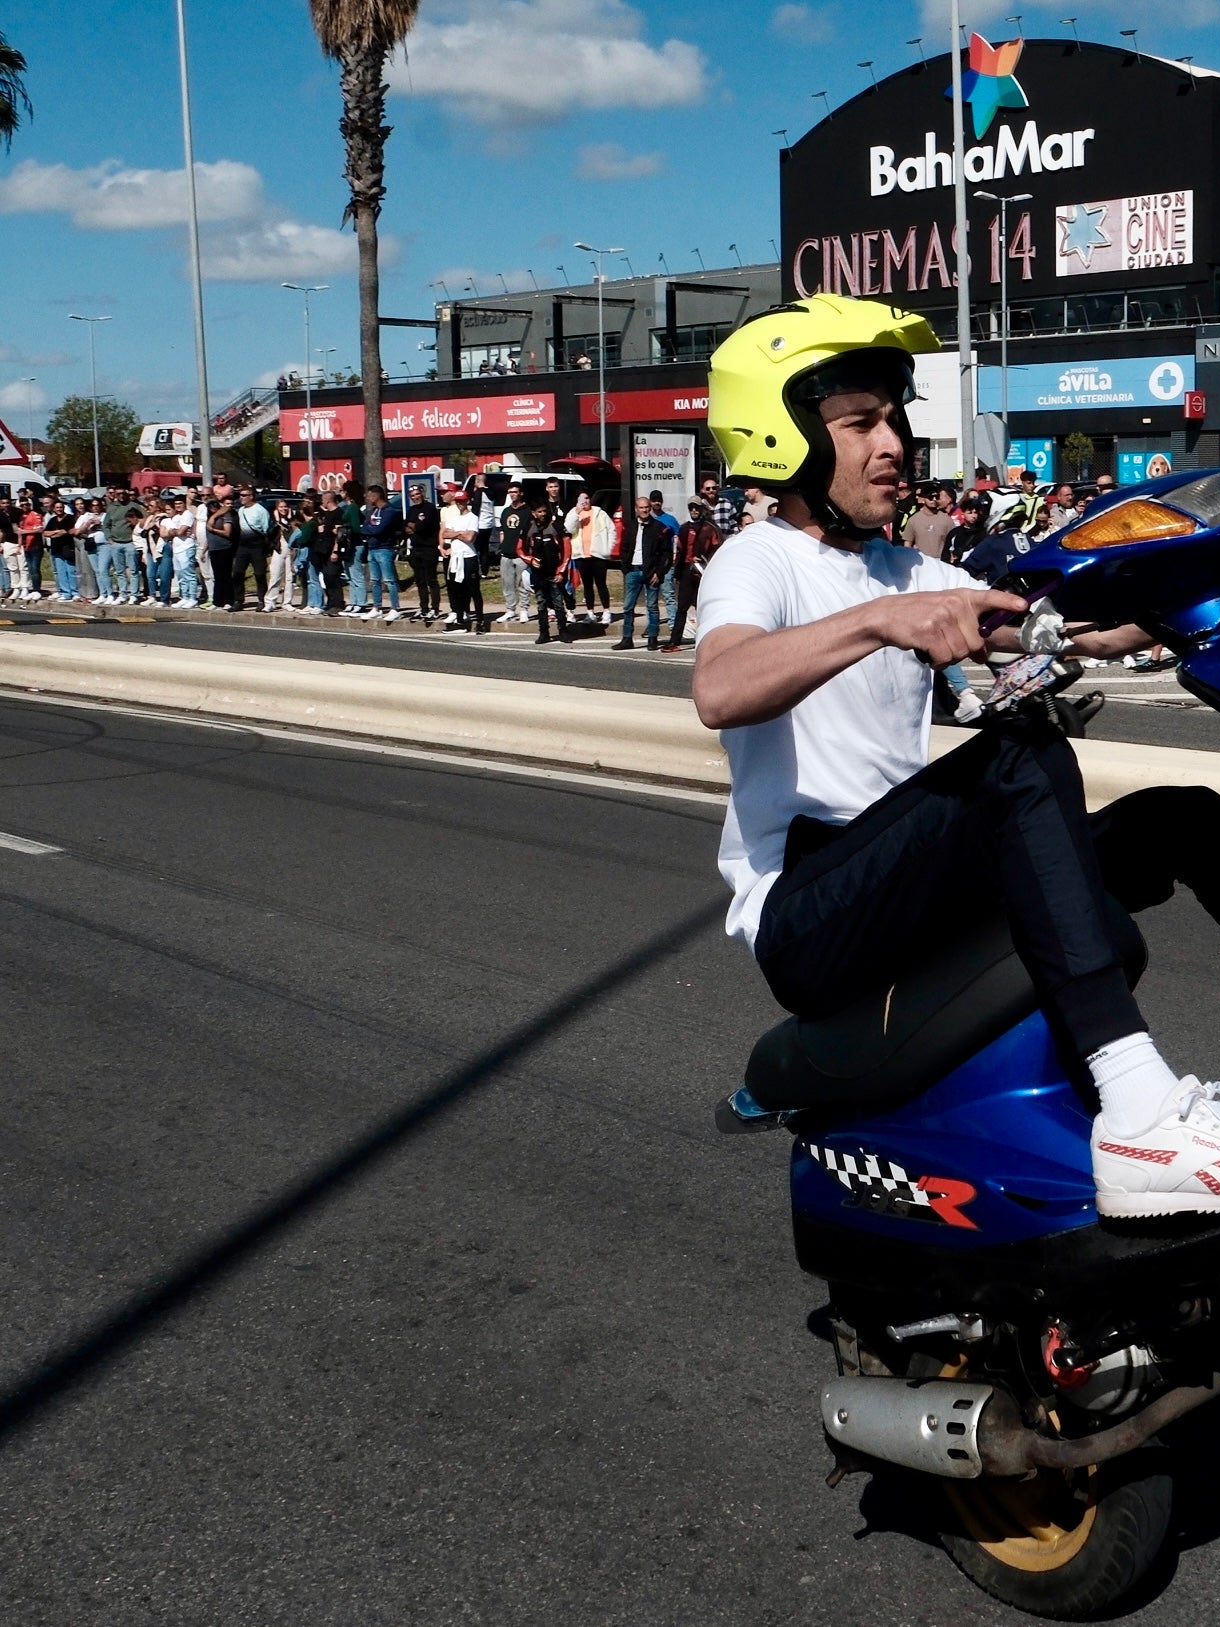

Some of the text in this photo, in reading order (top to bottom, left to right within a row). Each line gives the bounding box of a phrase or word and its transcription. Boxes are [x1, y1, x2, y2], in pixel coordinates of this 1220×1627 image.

[1128, 193, 1185, 212] UNION
[1127, 209, 1187, 254] CINE
[988, 212, 1037, 284] 14
[1128, 252, 1186, 269] CIUDAD
[674, 399, 690, 410] KIA
[1037, 392, 1135, 406] CLÍNICA VETERINARIA
[382, 409, 414, 432] males
[421, 406, 461, 428] felices
[635, 435, 647, 445] La
[634, 447, 690, 457] HUMANIDAD
[634, 460, 675, 471] es lo que
[751, 460, 788, 470] ACERBIS
[635, 473, 685, 481] nos mueve.
[915, 1175, 983, 1231] R
